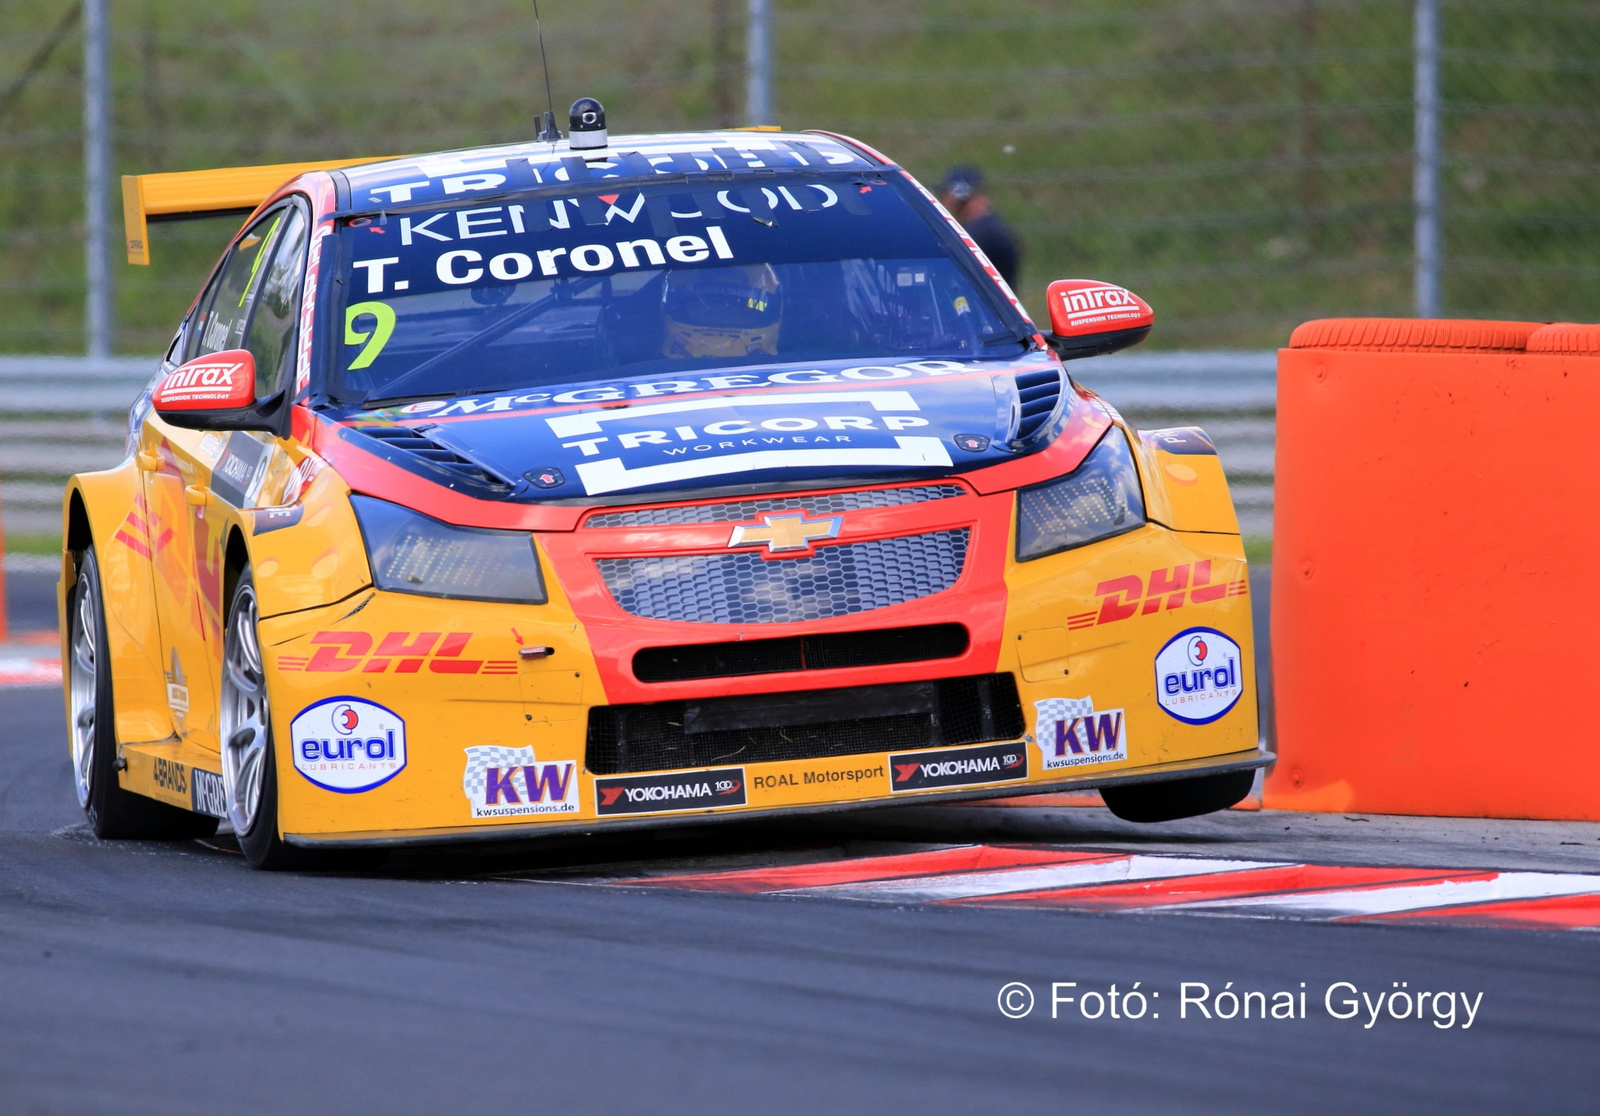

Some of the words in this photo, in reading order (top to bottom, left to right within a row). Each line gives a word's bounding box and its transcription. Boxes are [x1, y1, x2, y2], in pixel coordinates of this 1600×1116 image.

[352, 256, 409, 294] T.
[435, 226, 734, 285] Coronel
[1070, 316, 1106, 326] SUSPENSION
[1107, 312, 1141, 320] TECHNOLOGY
[345, 301, 396, 371] 9
[161, 395, 191, 404] SUSPENSION
[562, 415, 929, 456] TRICORP
[663, 434, 852, 456] WORKWEAR
[1094, 559, 1228, 625] DHL
[305, 631, 484, 674] DHL
[1164, 656, 1237, 696] eurol
[1165, 689, 1238, 706] LUBRICANTS
[301, 728, 397, 762] eurol
[1055, 711, 1123, 759] KW
[301, 762, 397, 771] LUBRICANTS
[920, 757, 1001, 778] YOKOHAMA
[1047, 751, 1124, 769] kwsuspensions.de
[484, 763, 576, 806] KW
[753, 774, 799, 789] ROAL
[803, 765, 884, 784] Motorsport
[624, 782, 713, 803] YOKOHAMA
[476, 802, 575, 817] kwsuspensions.de
